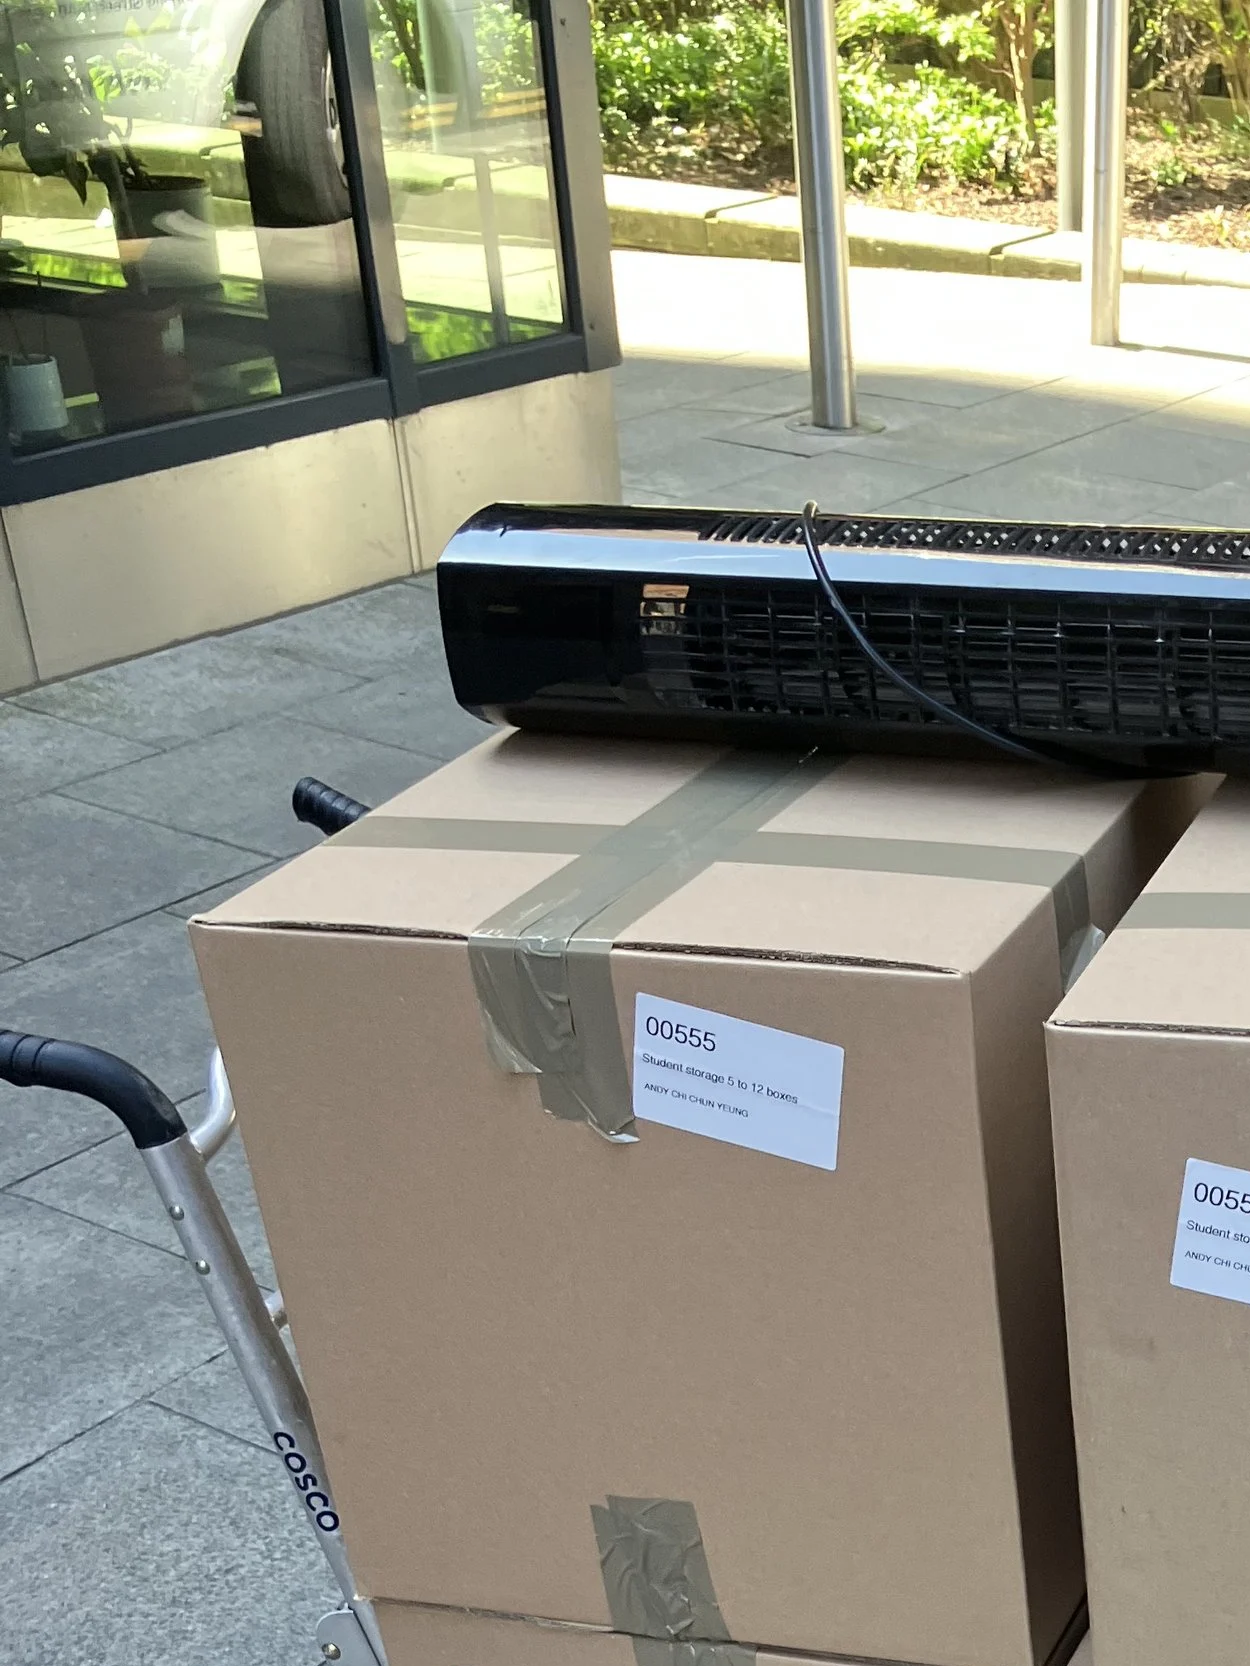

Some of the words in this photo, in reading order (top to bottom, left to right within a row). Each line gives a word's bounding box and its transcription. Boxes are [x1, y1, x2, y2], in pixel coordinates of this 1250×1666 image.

[646, 1016, 716, 1051] 00555
[642, 1053, 683, 1073] Student
[686, 1066, 724, 1084] storage
[727, 1076, 734, 1087] 5
[738, 1080, 747, 1090] to
[752, 1082, 763, 1095] 12
[767, 1087, 798, 1104] boxes
[644, 1083, 668, 1094] ANDY
[671, 1090, 686, 1100] CHI
[689, 1094, 714, 1108] CHUN
[717, 1102, 748, 1117] YEUNG
[1186, 1220, 1230, 1240] Student
[1185, 1250, 1211, 1263] ANDY
[1214, 1257, 1230, 1268] CHI
[274, 1432, 339, 1531] COSCO
